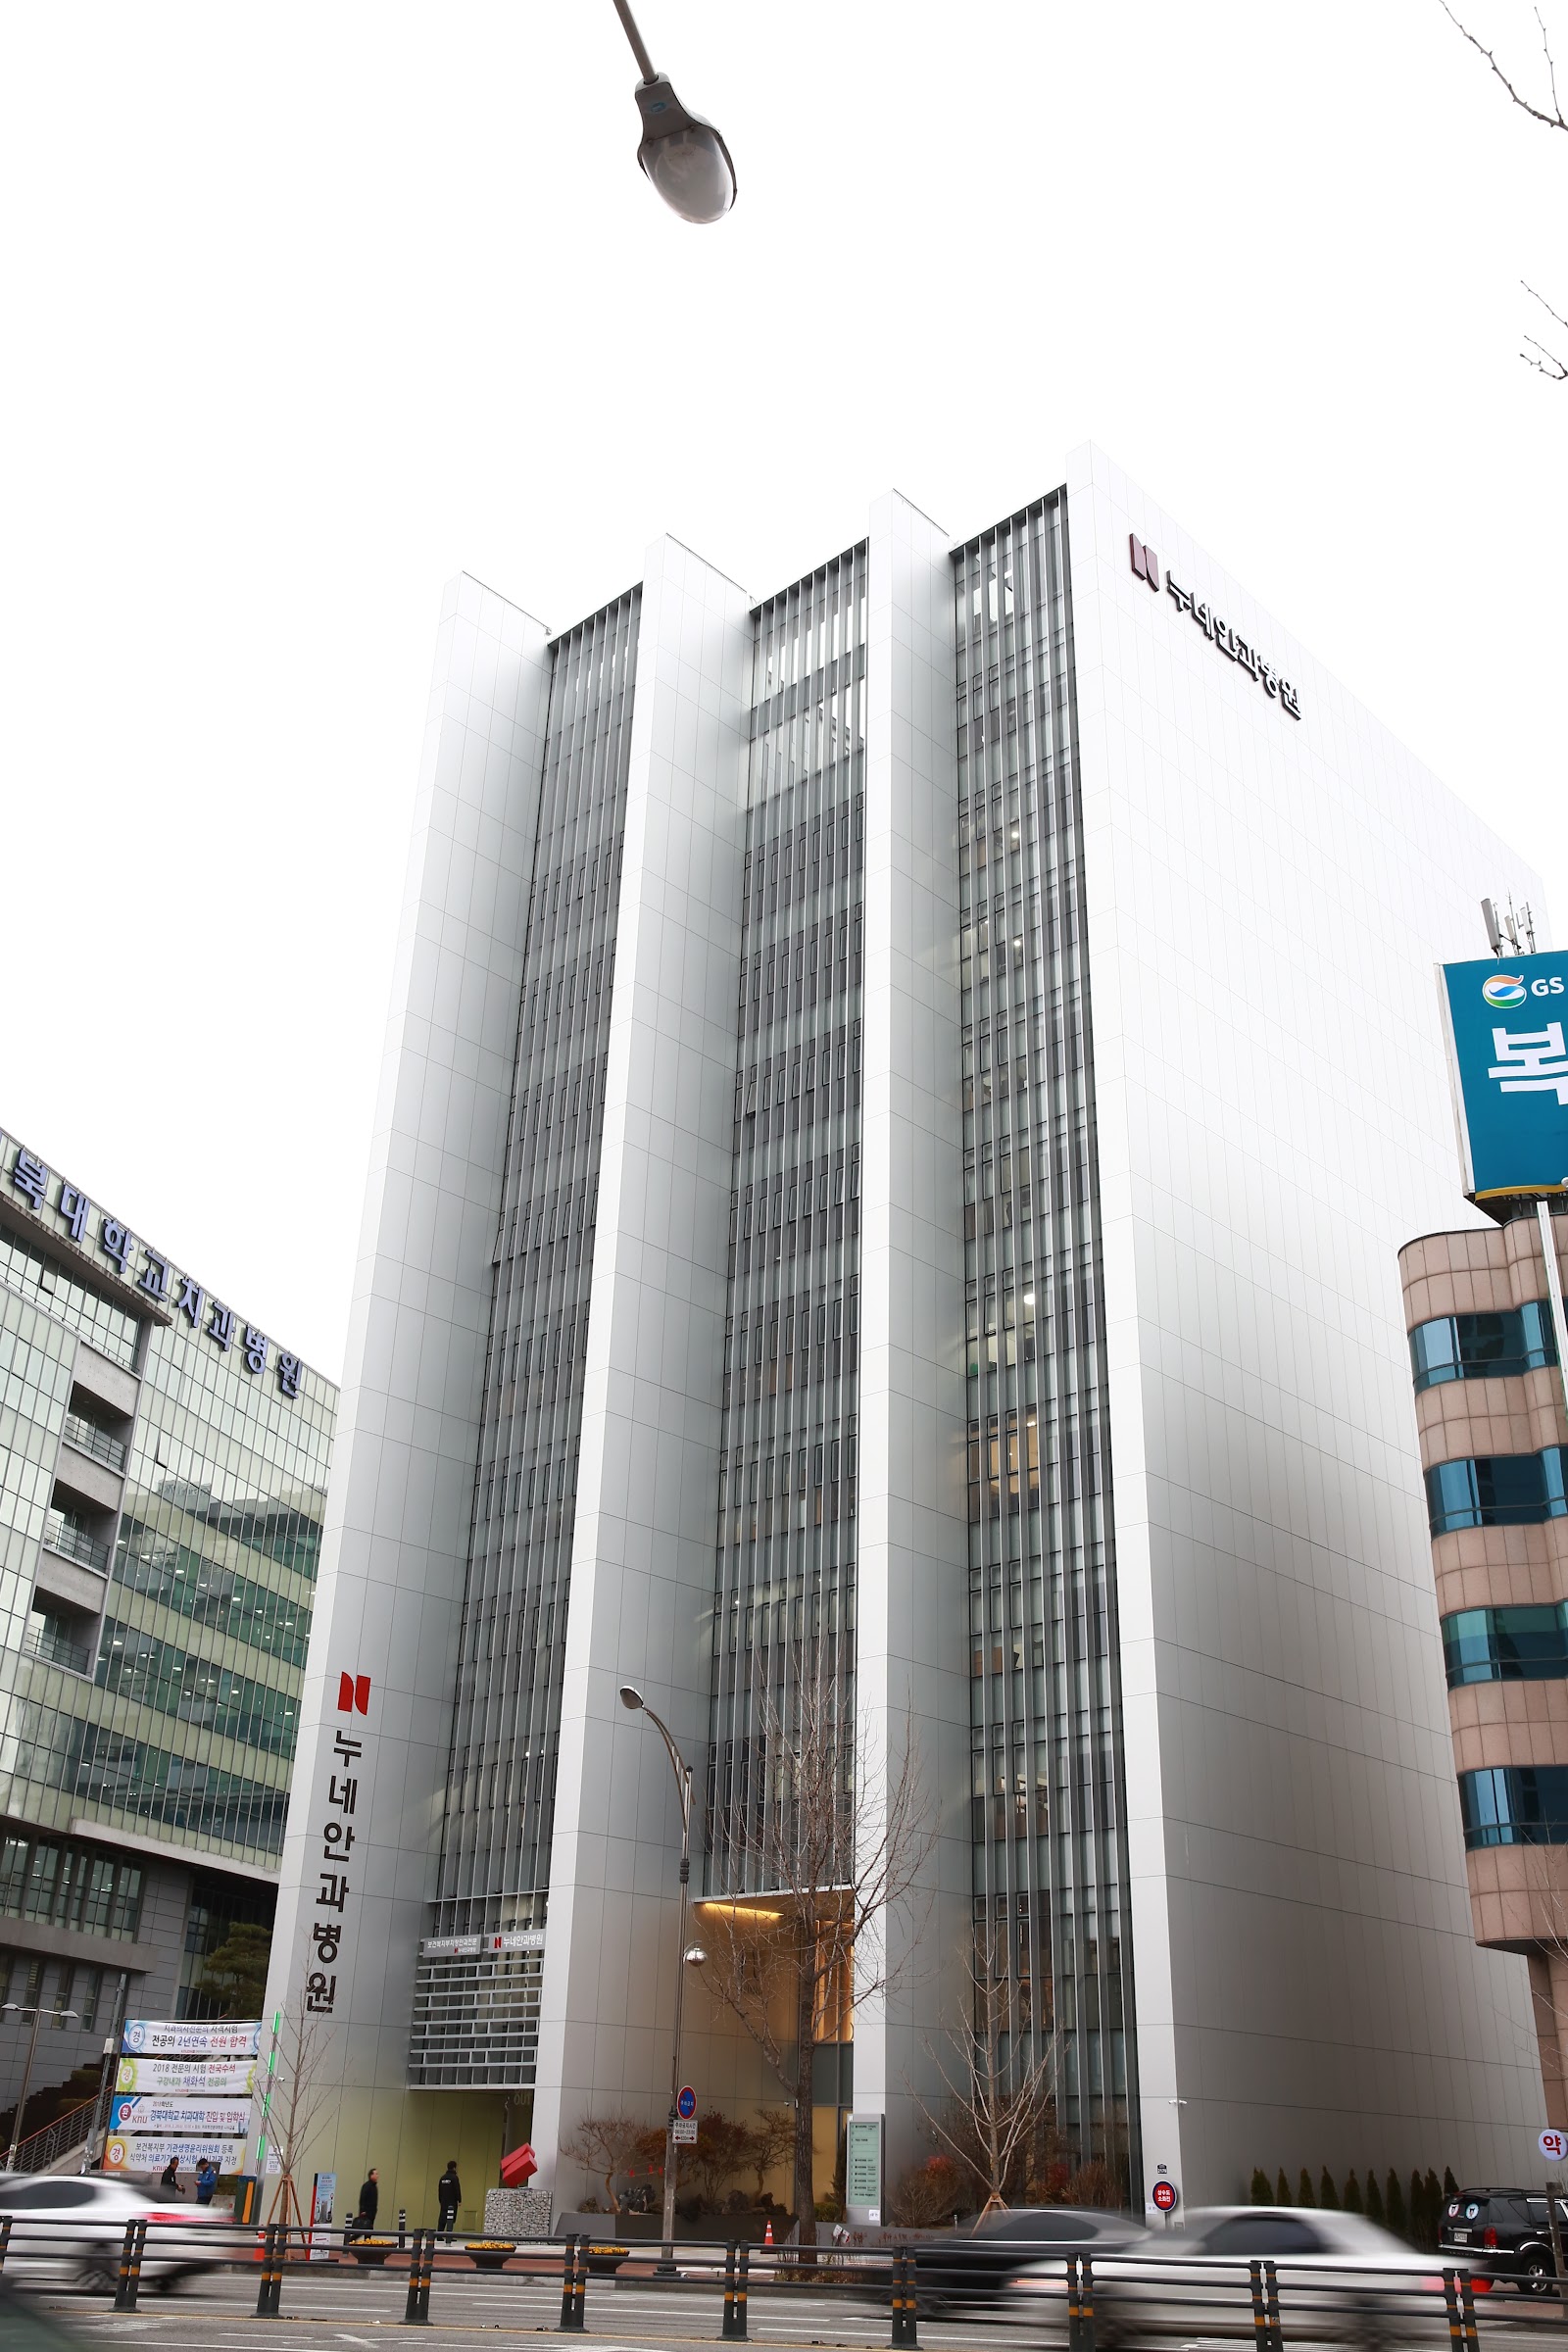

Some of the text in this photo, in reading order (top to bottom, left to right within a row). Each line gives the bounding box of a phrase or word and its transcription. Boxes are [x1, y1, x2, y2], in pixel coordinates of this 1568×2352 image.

[1166, 569, 1301, 720] 누네안과병원
[1531, 976, 1565, 997] GS
[1488, 1021, 1568, 1105] 복
[0, 1132, 303, 1400] 북대학교치과병원
[306, 1730, 362, 2014] 누네안과병원
[504, 1934, 544, 1947] 누네안과병원
[152, 2034, 247, 2048] 전공의 2년연속 전원 합격
[153, 2063, 236, 2074] 2018 전문의 시험 전국수석
[157, 2077, 181, 2086] 구강내과
[207, 2077, 227, 2087] 전공의
[150, 2109, 180, 2122] 경북대학교
[180, 2110, 206, 2123] 치과대학
[206, 2111, 219, 2123] 진입
[135, 2141, 234, 2154] 보건복지부 기관생명윤리위원회 등록
[1543, 2134, 1561, 2155] 약
[112, 2147, 121, 2161] 경
[224, 2155, 237, 2166] 지정
